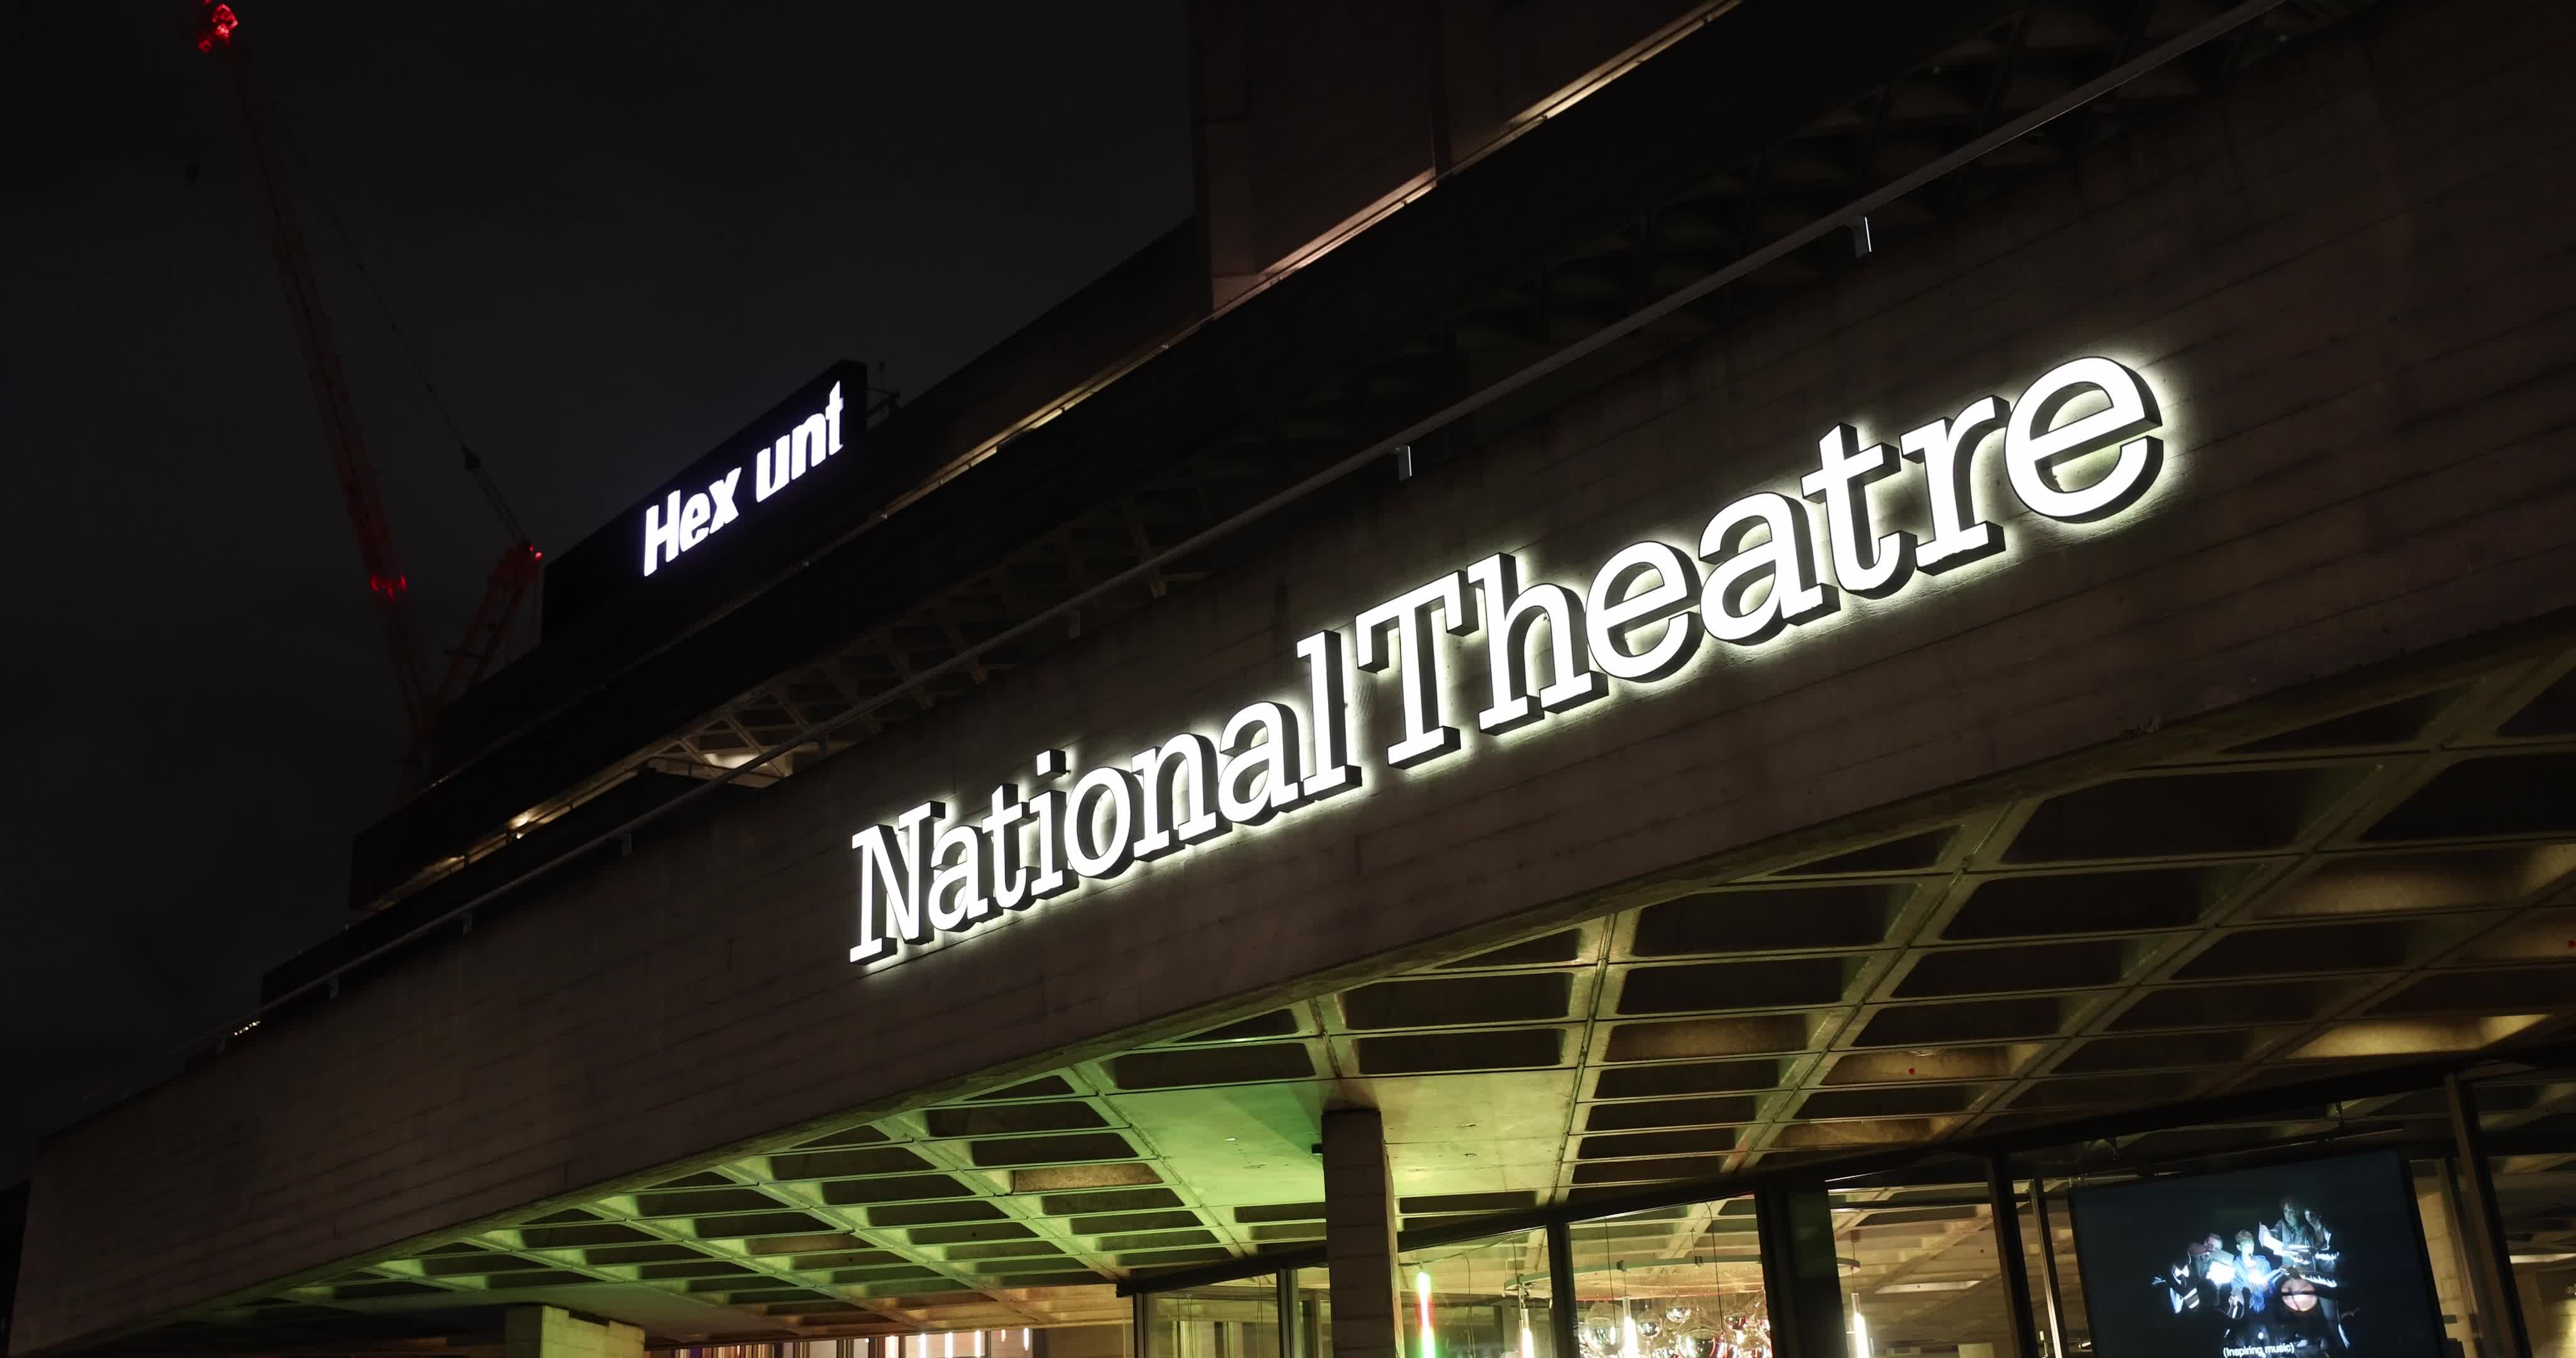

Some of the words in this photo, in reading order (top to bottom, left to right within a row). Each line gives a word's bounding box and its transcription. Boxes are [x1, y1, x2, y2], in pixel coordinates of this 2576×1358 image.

[643, 466, 741, 577] Hex
[756, 380, 843, 502] unt
[850, 630, 1362, 964] National
[1356, 356, 2162, 768] Theatre
[2265, 1342, 2294, 1354] music)
